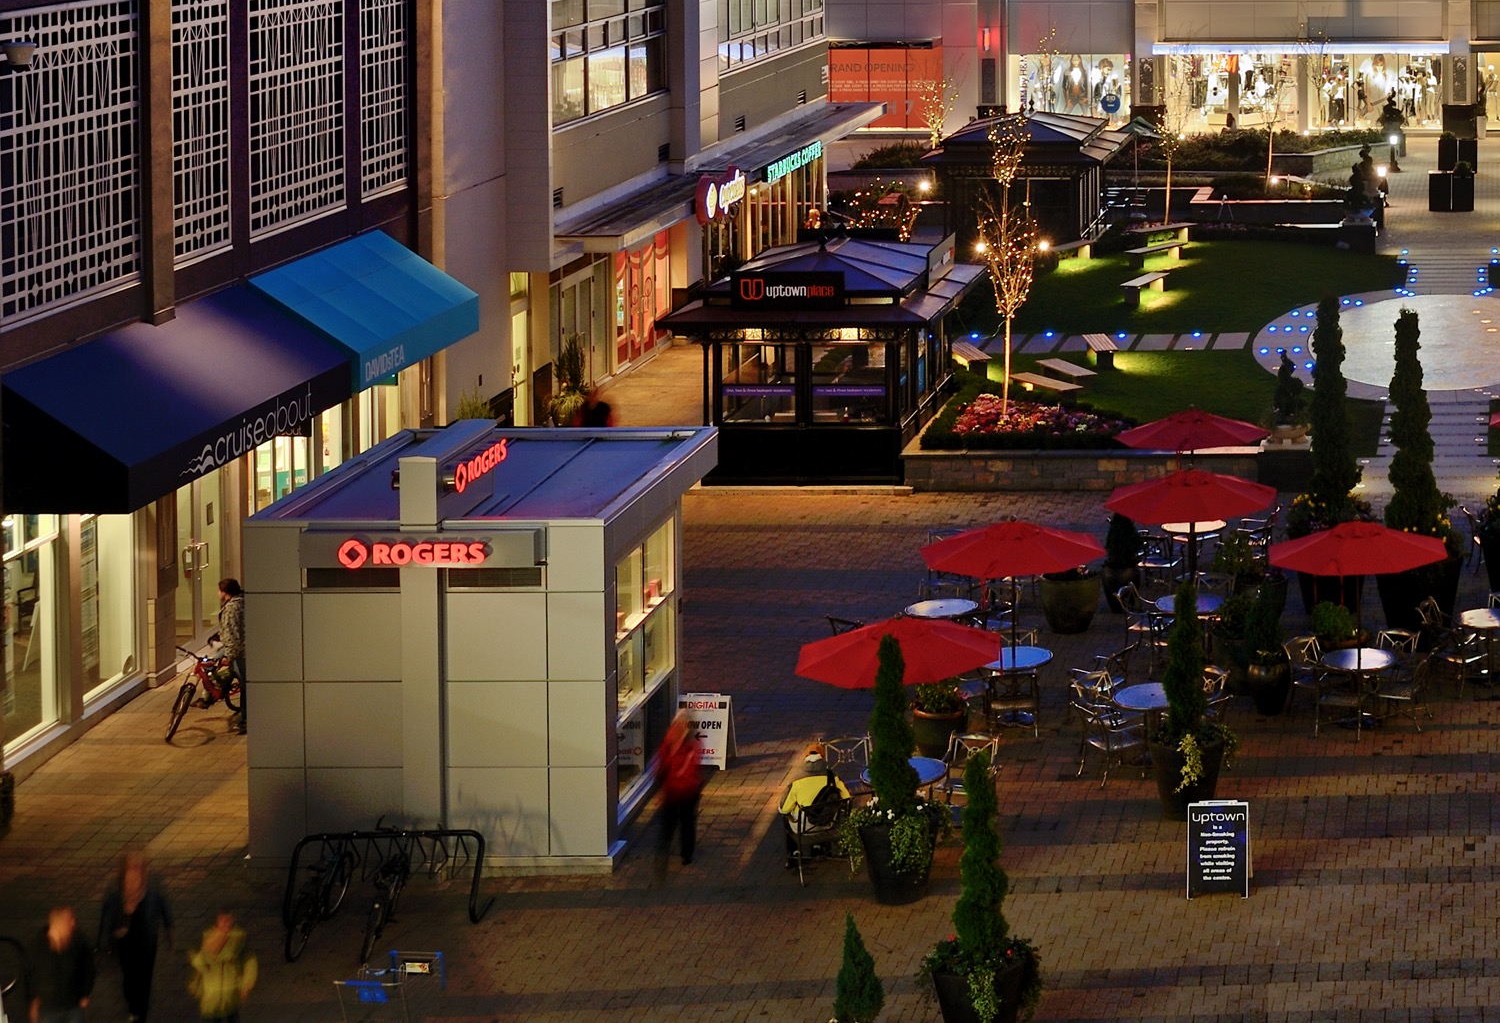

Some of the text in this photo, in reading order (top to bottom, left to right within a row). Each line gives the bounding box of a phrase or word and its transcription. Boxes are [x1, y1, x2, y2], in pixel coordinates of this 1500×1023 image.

[830, 63, 915, 73] RAND OPENING
[767, 140, 822, 184] STARBUCKS COFFEE
[467, 438, 508, 483] ROGERS
[372, 542, 486, 566] ROGERS
[688, 701, 718, 710] DIGITAL
[687, 721, 722, 730] OW OPEN
[1192, 812, 1245, 824] uptown
